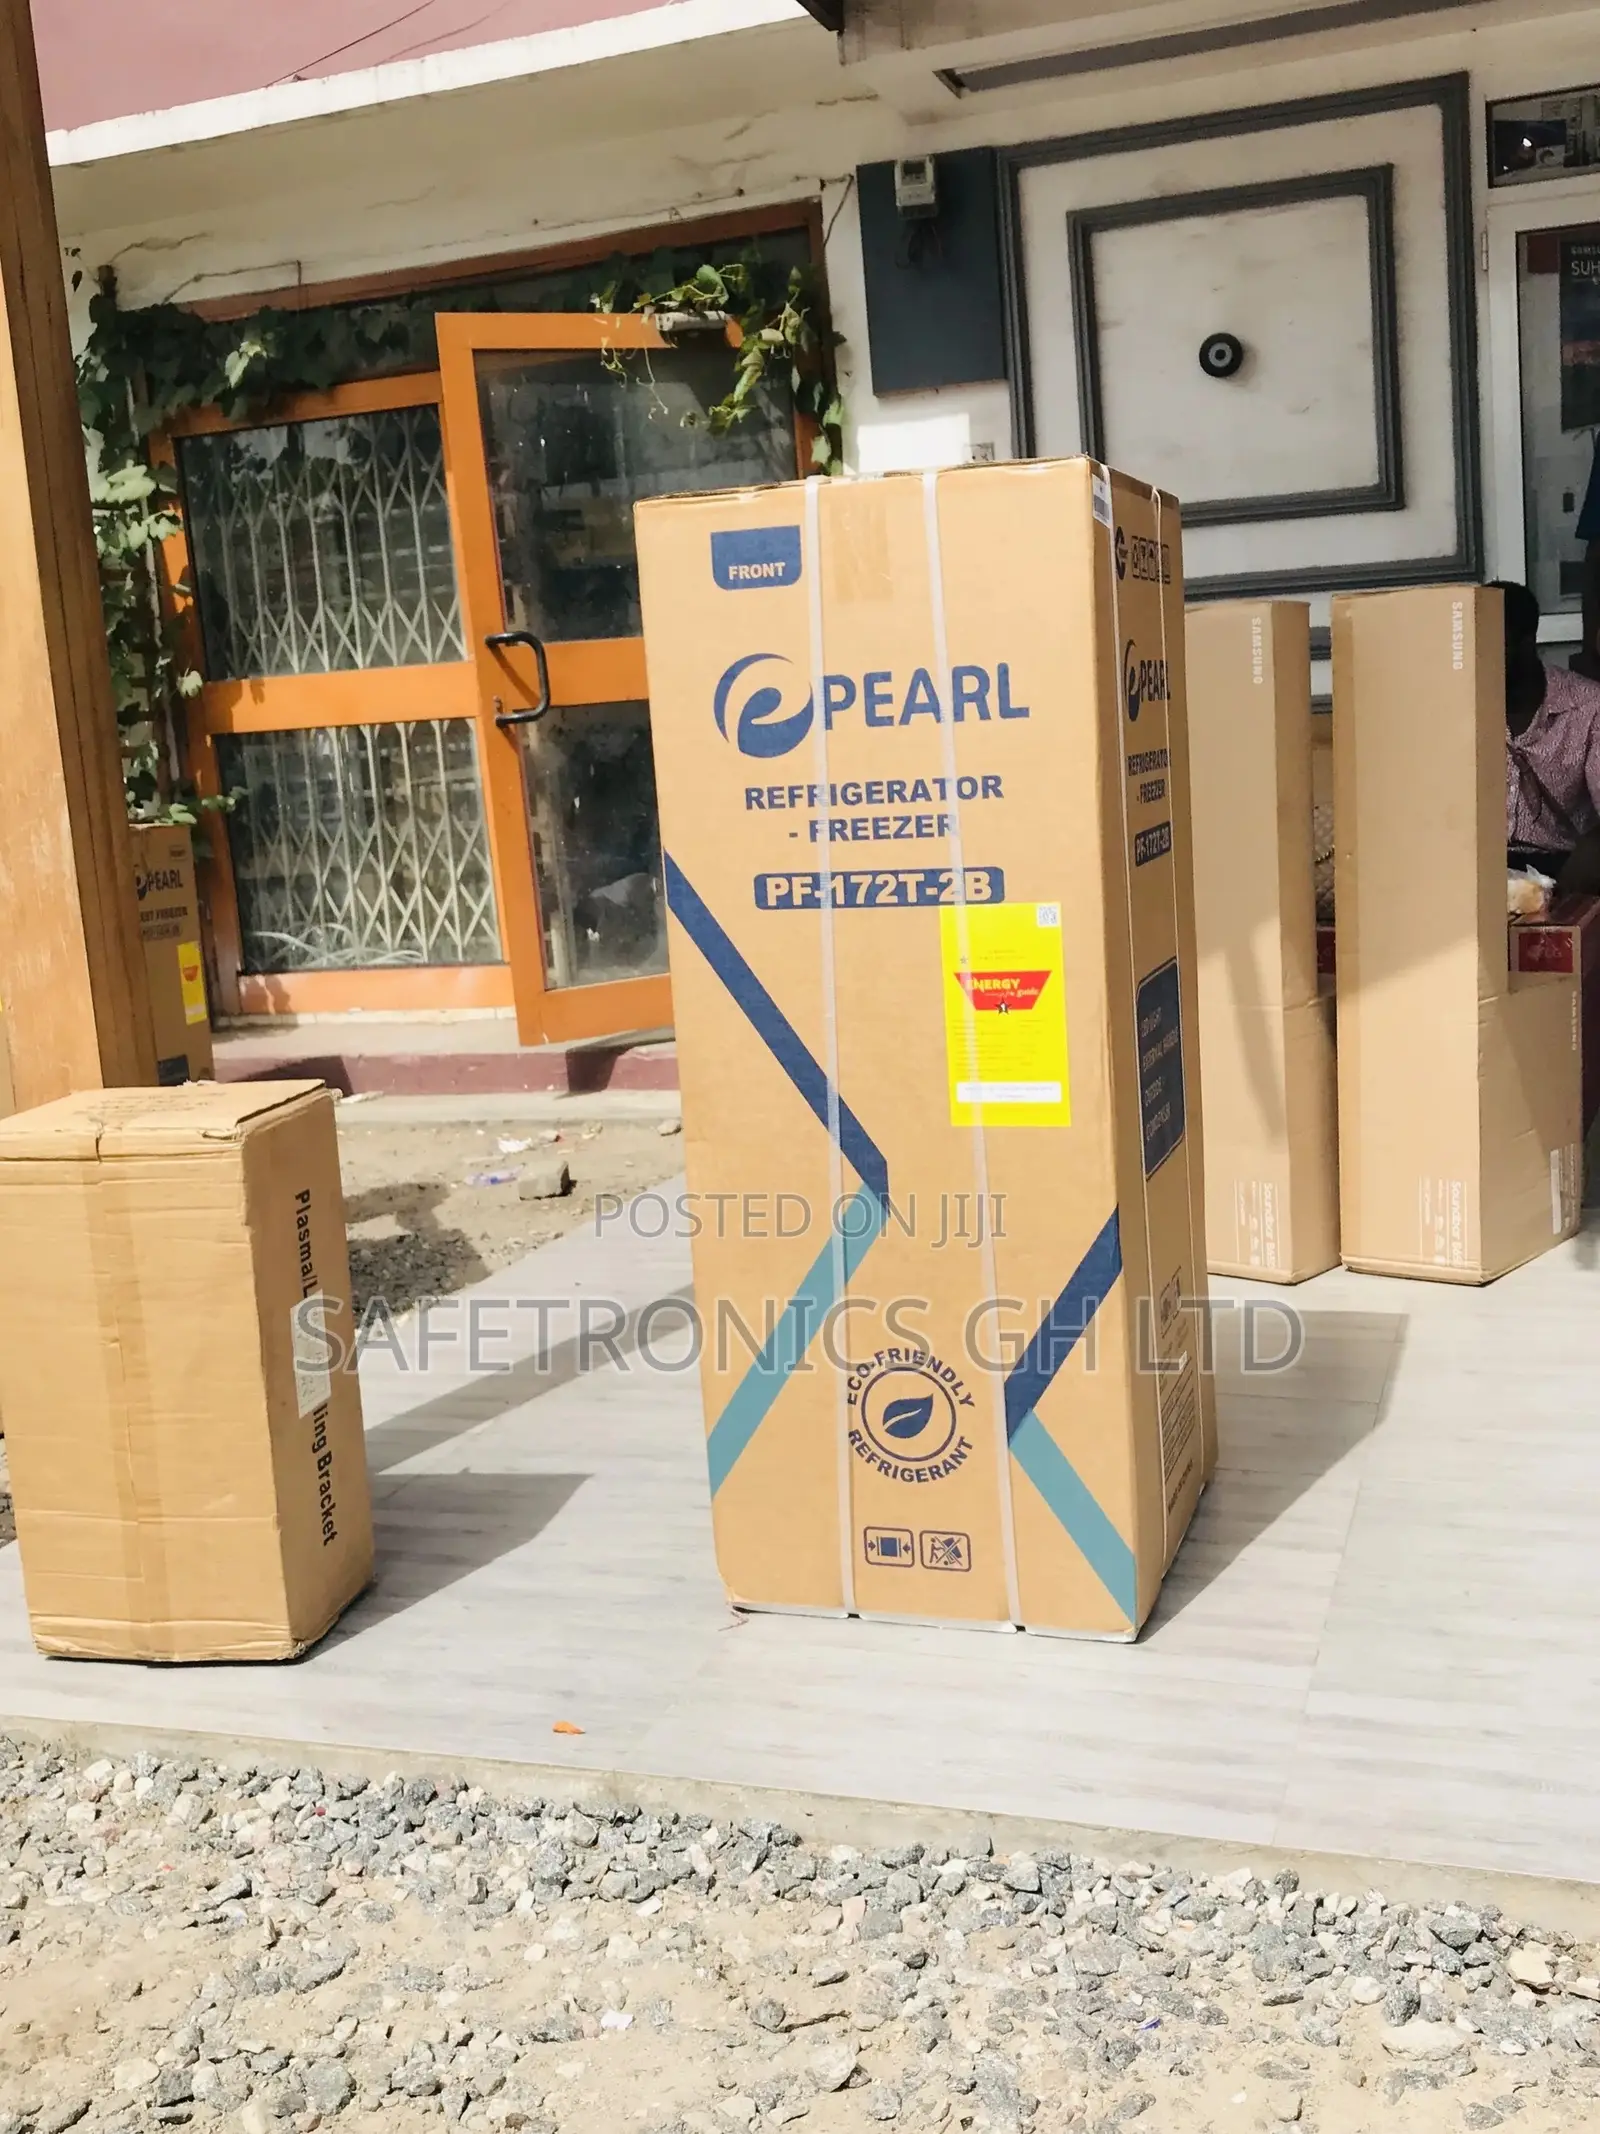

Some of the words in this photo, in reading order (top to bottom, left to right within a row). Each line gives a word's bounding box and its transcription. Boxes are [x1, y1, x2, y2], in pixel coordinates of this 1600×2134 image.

[727, 561, 786, 580] FRONT
[1251, 616, 1264, 685] SAMSUNG
[1452, 601, 1464, 671] SAMSUNG
[821, 662, 1031, 731] PEARL
[1140, 659, 1171, 703] PEARL
[744, 774, 1005, 811] REFRIGERATOR
[808, 813, 959, 844] FREEZER
[766, 869, 993, 907] PF-172T-2B
[967, 977, 1021, 993] ENERGY
[846, 1347, 976, 1406] ECO-FRIENDLY
[847, 1428, 974, 1484] REFRIGERANT
[316, 1453, 339, 1547] Bracket
